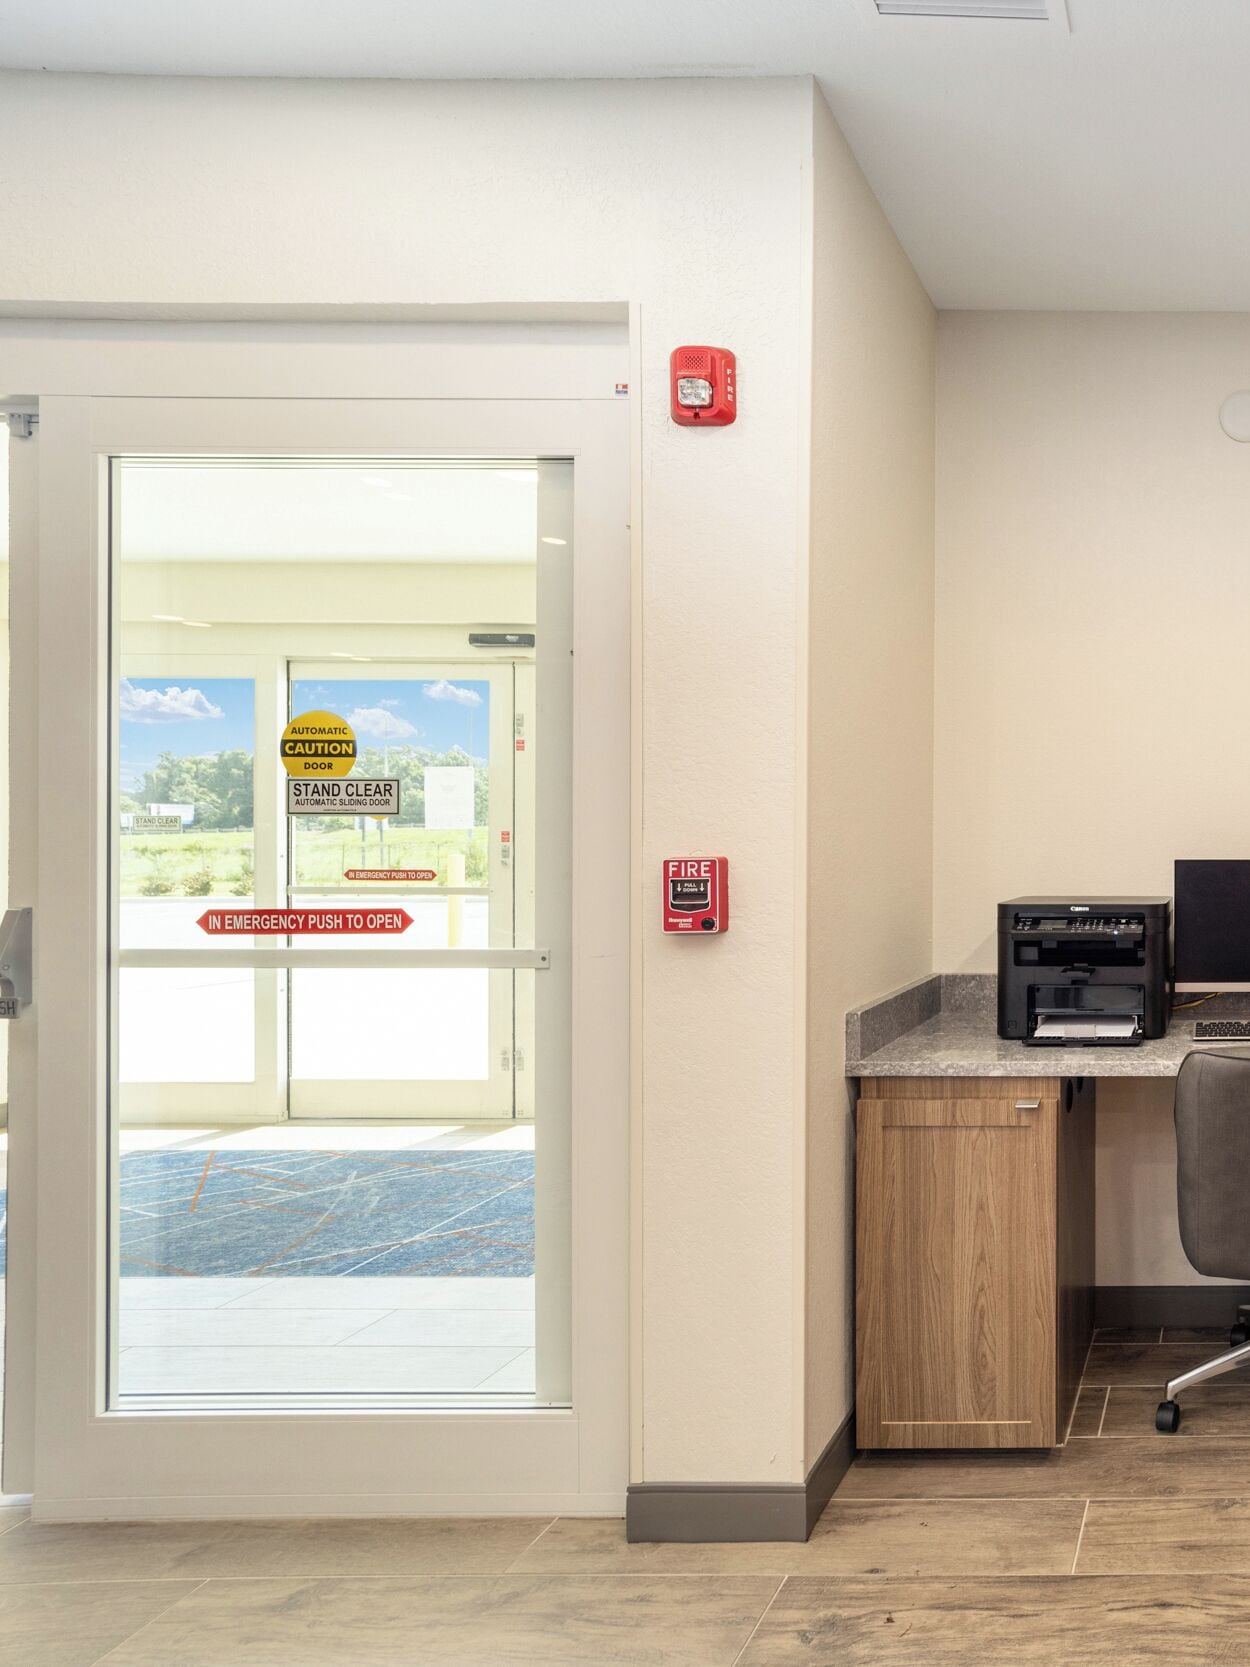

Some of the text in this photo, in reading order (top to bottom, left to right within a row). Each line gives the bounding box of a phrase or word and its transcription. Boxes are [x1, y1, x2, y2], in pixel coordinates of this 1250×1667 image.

[726, 368, 734, 402] FIRE
[291, 727, 348, 735] AUTOMATIC
[285, 742, 353, 754] CAUTION
[304, 762, 333, 770] DOOR
[293, 783, 393, 797] STAND CLEAR
[348, 871, 432, 879] IN EMERGENCY PUSH TO OPEN
[668, 862, 711, 877] FIRE
[208, 914, 402, 930] IN EMERGENCY PUSH TO OPEN
